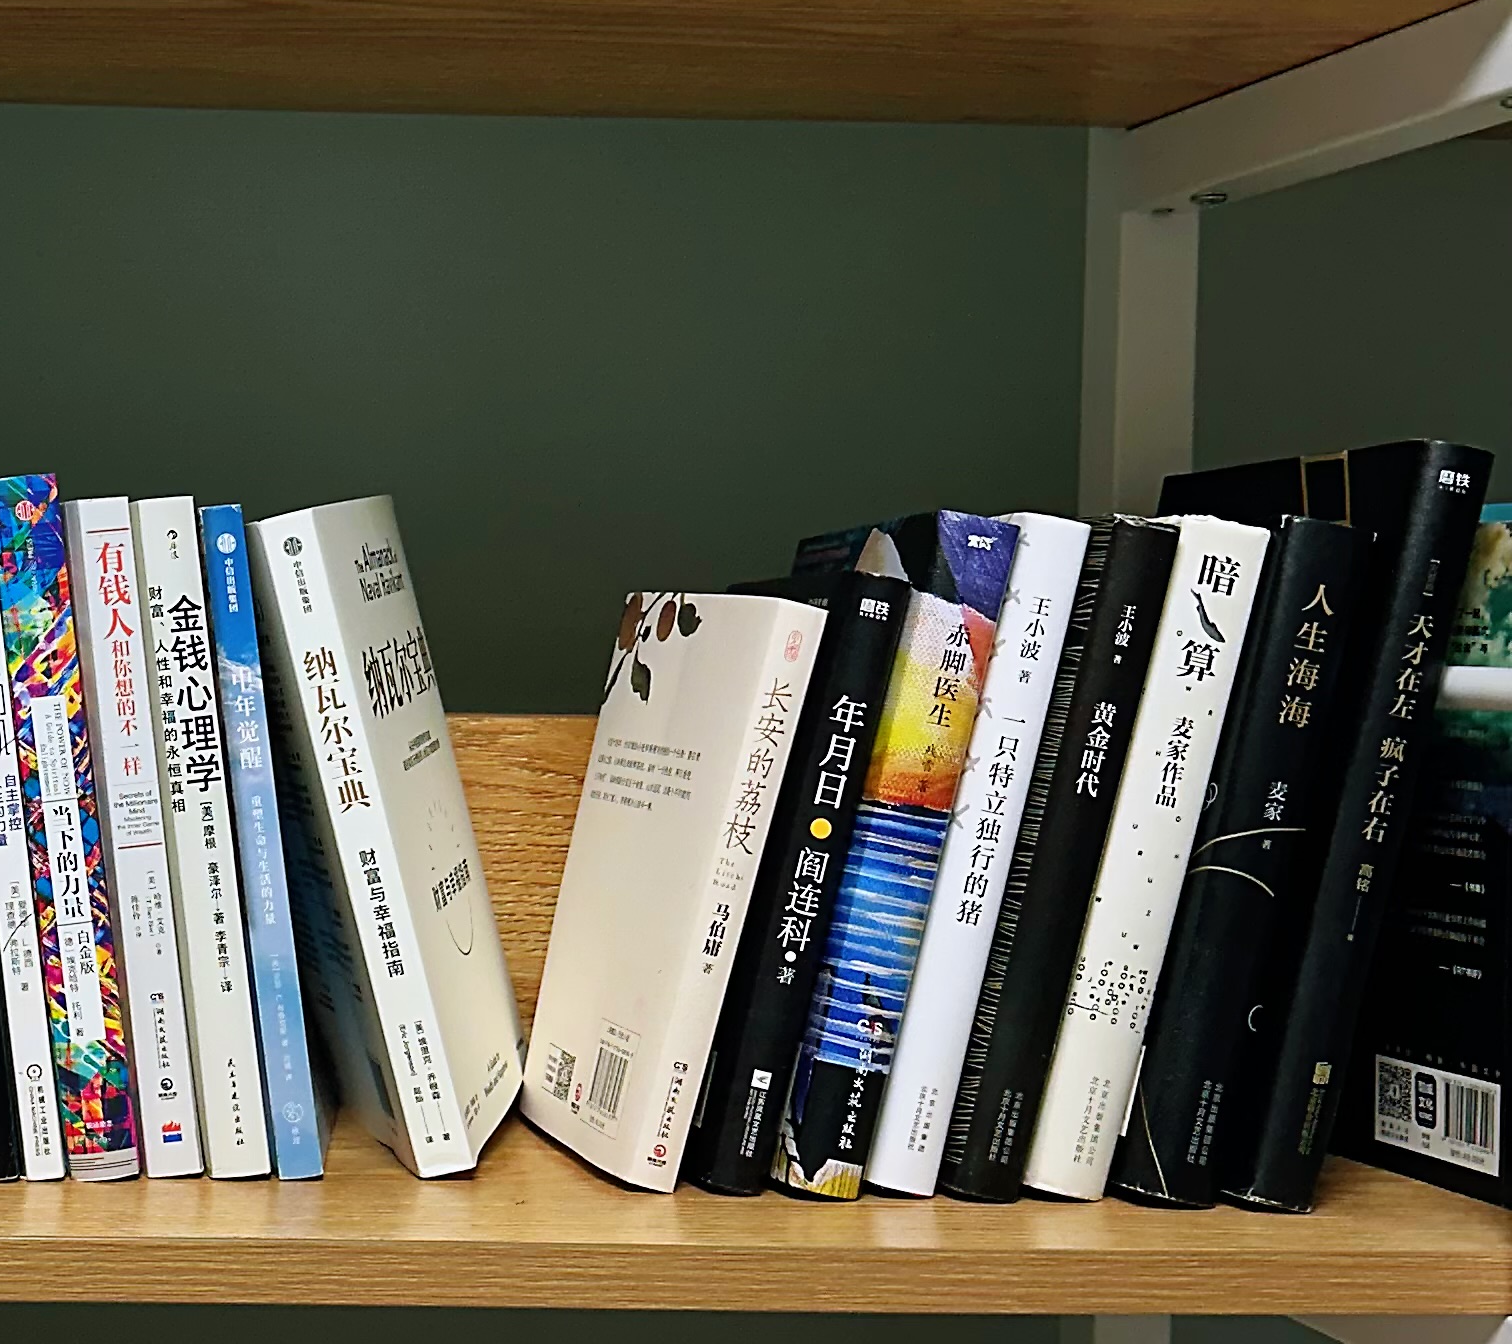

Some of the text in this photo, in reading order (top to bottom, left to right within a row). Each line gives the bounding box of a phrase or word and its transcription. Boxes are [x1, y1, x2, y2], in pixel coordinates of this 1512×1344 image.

[95, 541, 143, 777] 有钱人和你想的不一样
[926, 622, 970, 729] 赤脚医生
[1177, 554, 1241, 683] 暗算
[1278, 584, 1335, 729] 人生海海
[166, 594, 222, 792] 金钱心理学
[231, 667, 263, 770] 中年觉醒
[303, 645, 372, 814] 纳瓦尔宝典
[813, 694, 868, 811] 年月日
[1075, 701, 1118, 798] 黄金时代
[1361, 613, 1435, 844] 天才在左 疯子在右
[722, 676, 793, 856] 长安的荔枝
[955, 595, 1053, 927] 王小波 一只特立独行的猪
[1154, 715, 1194, 809] 麦家作品
[53, 805, 85, 919] 当下的力量
[358, 847, 405, 978] 财富与幸福指南
[776, 847, 831, 952] 阎连科
[701, 901, 731, 958] 马伯庸
